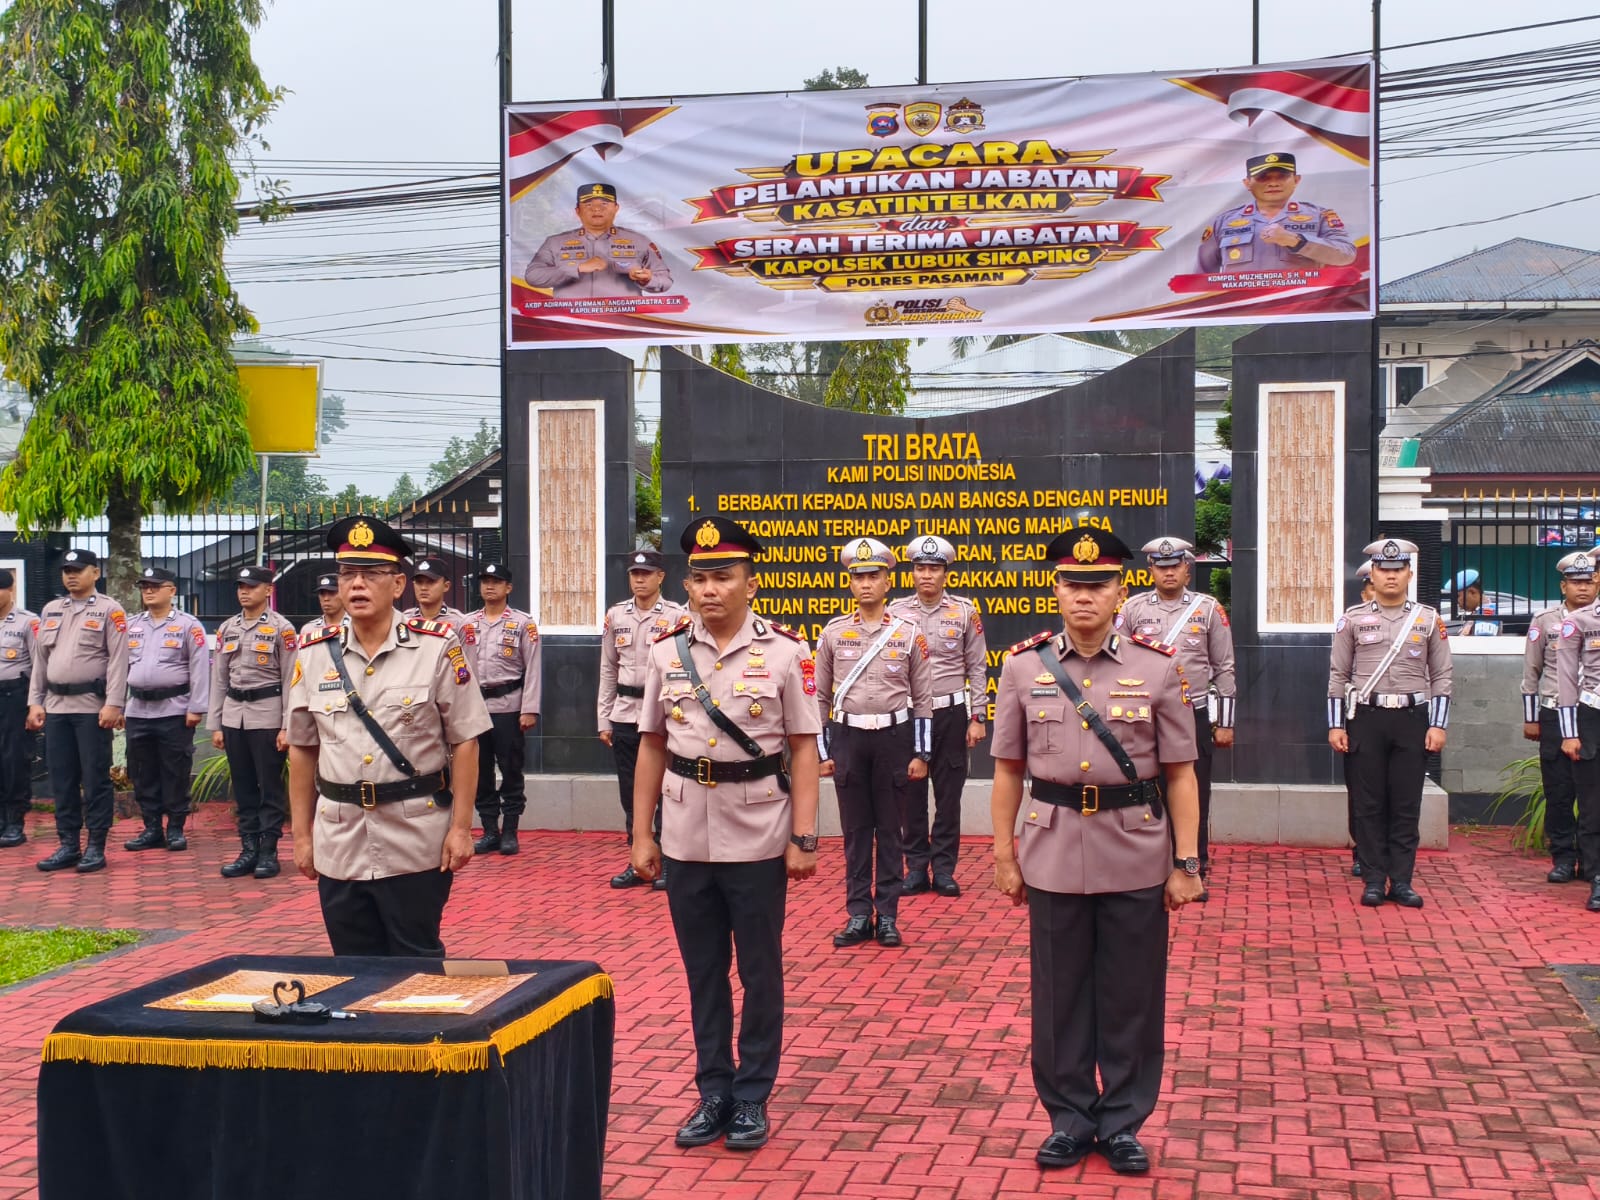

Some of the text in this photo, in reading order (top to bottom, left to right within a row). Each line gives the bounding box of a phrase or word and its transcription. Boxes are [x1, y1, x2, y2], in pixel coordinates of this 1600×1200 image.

[795, 140, 1057, 176] UPACARA
[734, 169, 1119, 206] PELANTIKAN JABATAN
[793, 192, 1057, 220] KASATINTELKAM
[899, 215, 950, 232] dan
[734, 224, 1119, 257] SERAH TERIMA JABATAN
[765, 248, 1091, 275] KAPOLSEK LUBUK SIKAPING
[846, 272, 1004, 287] POLRES PASAMAN
[893, 298, 943, 309] POLISI
[863, 432, 981, 462] TRI BRATA
[827, 463, 1016, 483] KAMI POLISI INDONESIA
[687, 488, 1168, 512] 1. BERBAKTI KEPADA NUSA DAN BANGSA DENGAN PENUH
[823, 518, 911, 537] TERHADAP
[914, 517, 971, 536] TUHAN
[975, 516, 1020, 535] YANG
[1025, 516, 1073, 534] MAHA
[755, 571, 836, 589] ANUSIAAN
[1022, 569, 1058, 587] HUK
[750, 597, 803, 615] ATUAN
[985, 597, 1036, 615] YANG
[1187, 616, 1205, 624] OLRI
[1359, 624, 1381, 632] RIZKY
